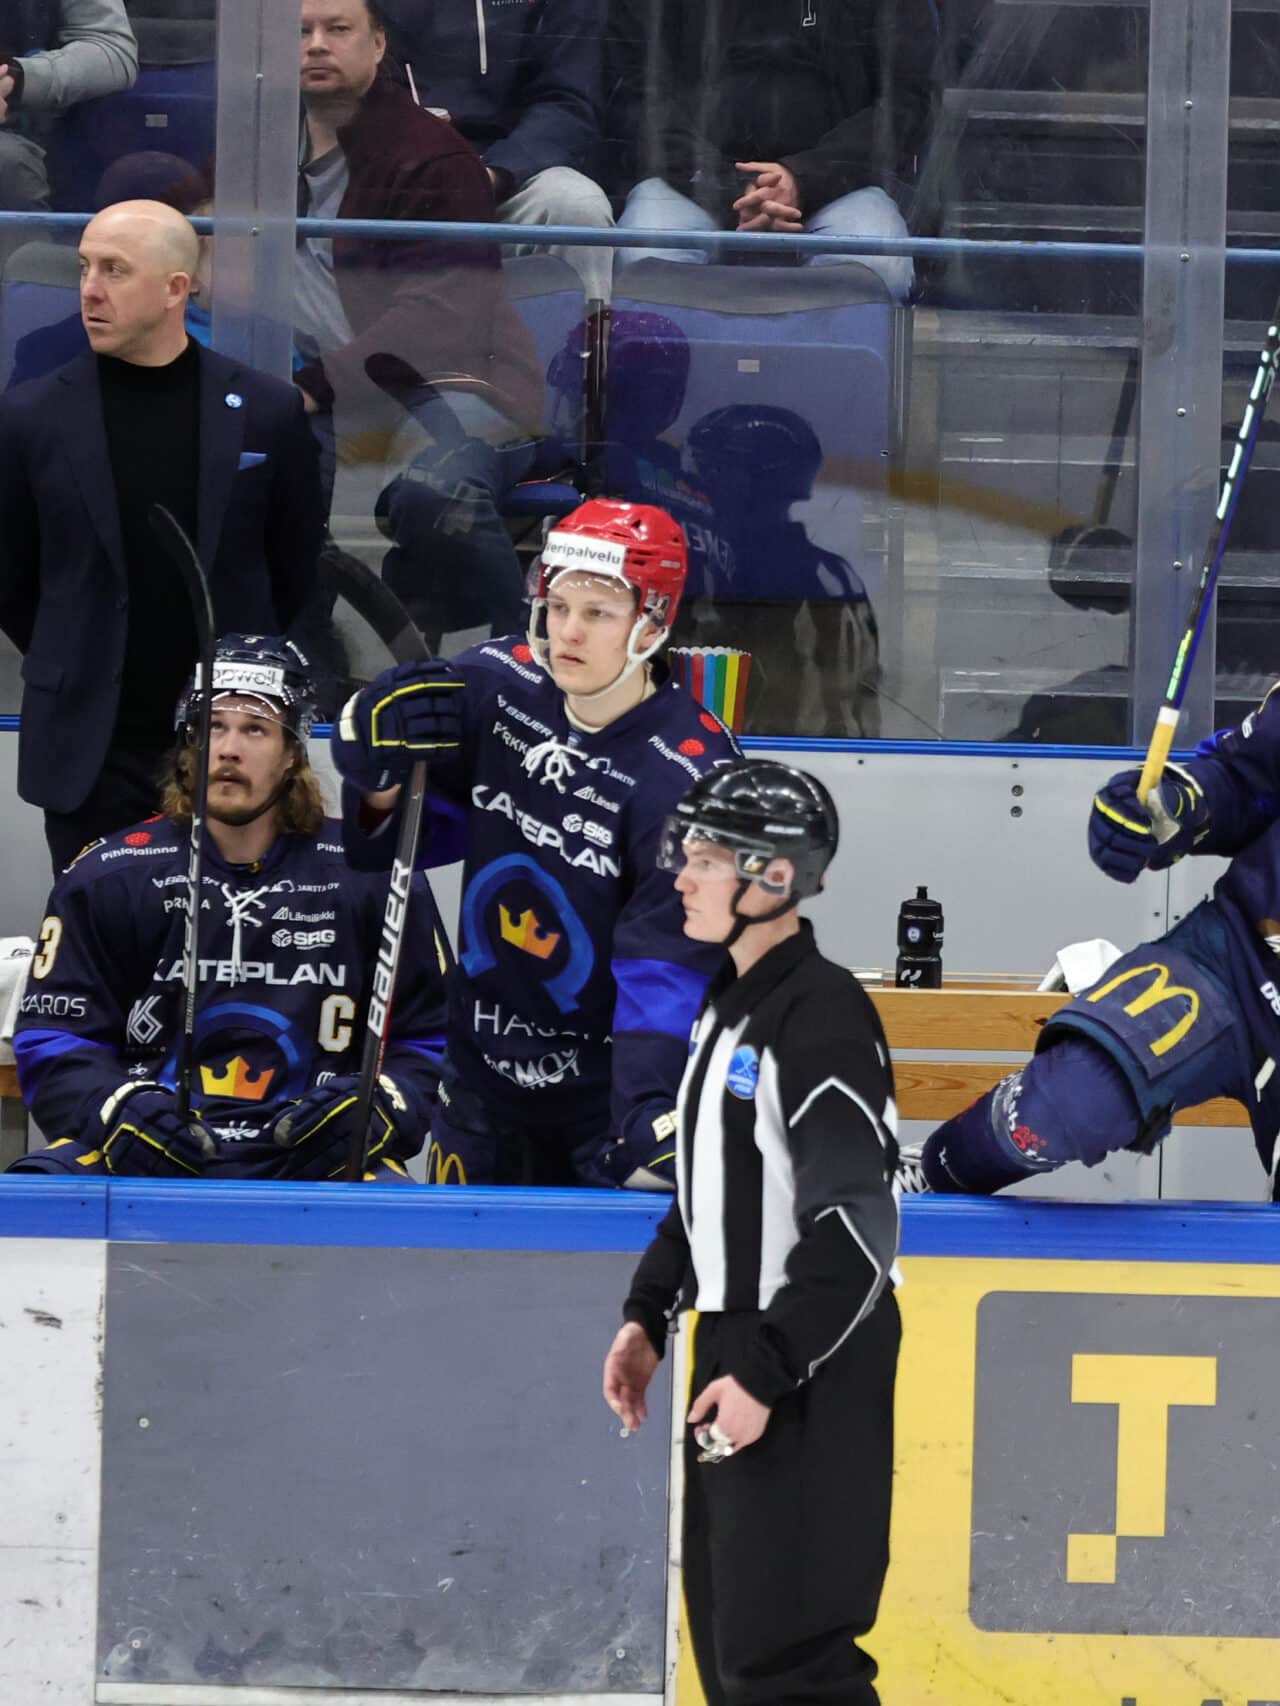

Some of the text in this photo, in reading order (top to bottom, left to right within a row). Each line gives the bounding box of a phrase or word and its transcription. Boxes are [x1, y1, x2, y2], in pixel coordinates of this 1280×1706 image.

[101, 846, 178, 862] Pihlajalinna
[294, 930, 336, 946] SRG
[367, 858, 410, 1039] BAUER
[318, 993, 356, 1053] C
